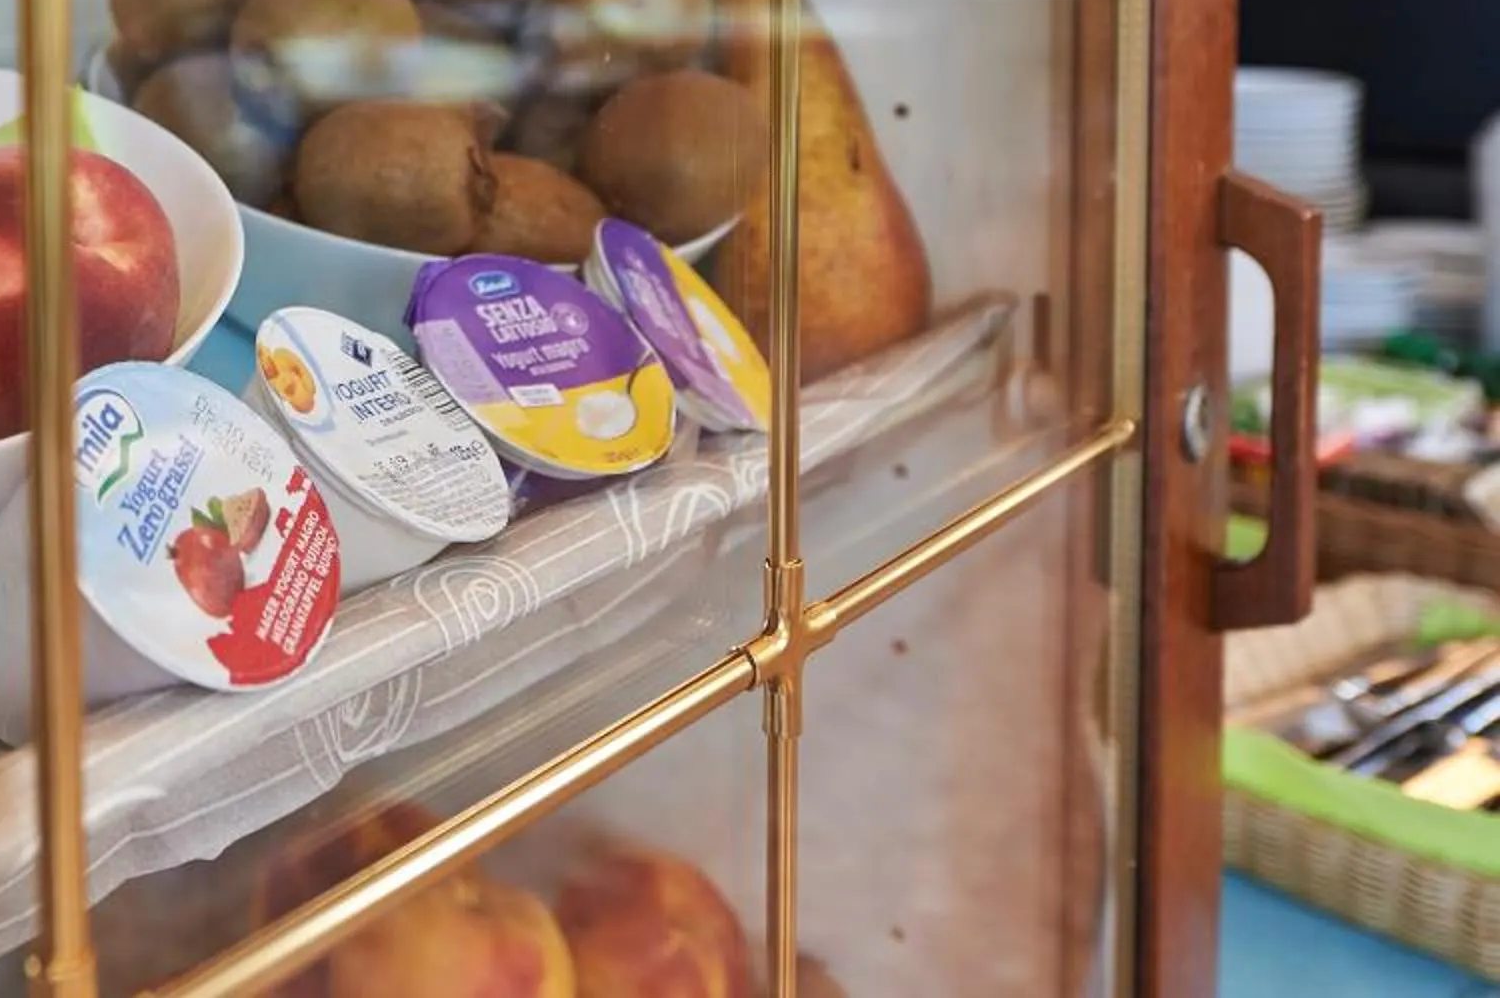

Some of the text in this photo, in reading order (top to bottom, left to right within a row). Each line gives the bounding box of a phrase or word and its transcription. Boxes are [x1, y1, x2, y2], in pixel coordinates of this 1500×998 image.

[476, 294, 548, 329] SENZA
[335, 369, 393, 403] YOGURT
[349, 391, 412, 422] INTERO
[76, 402, 125, 474] mila
[116, 433, 200, 562] Zero grassi
[118, 448, 168, 518] Yogurt
[273, 549, 301, 599] YOGURT
[295, 510, 320, 553] MAGRO
